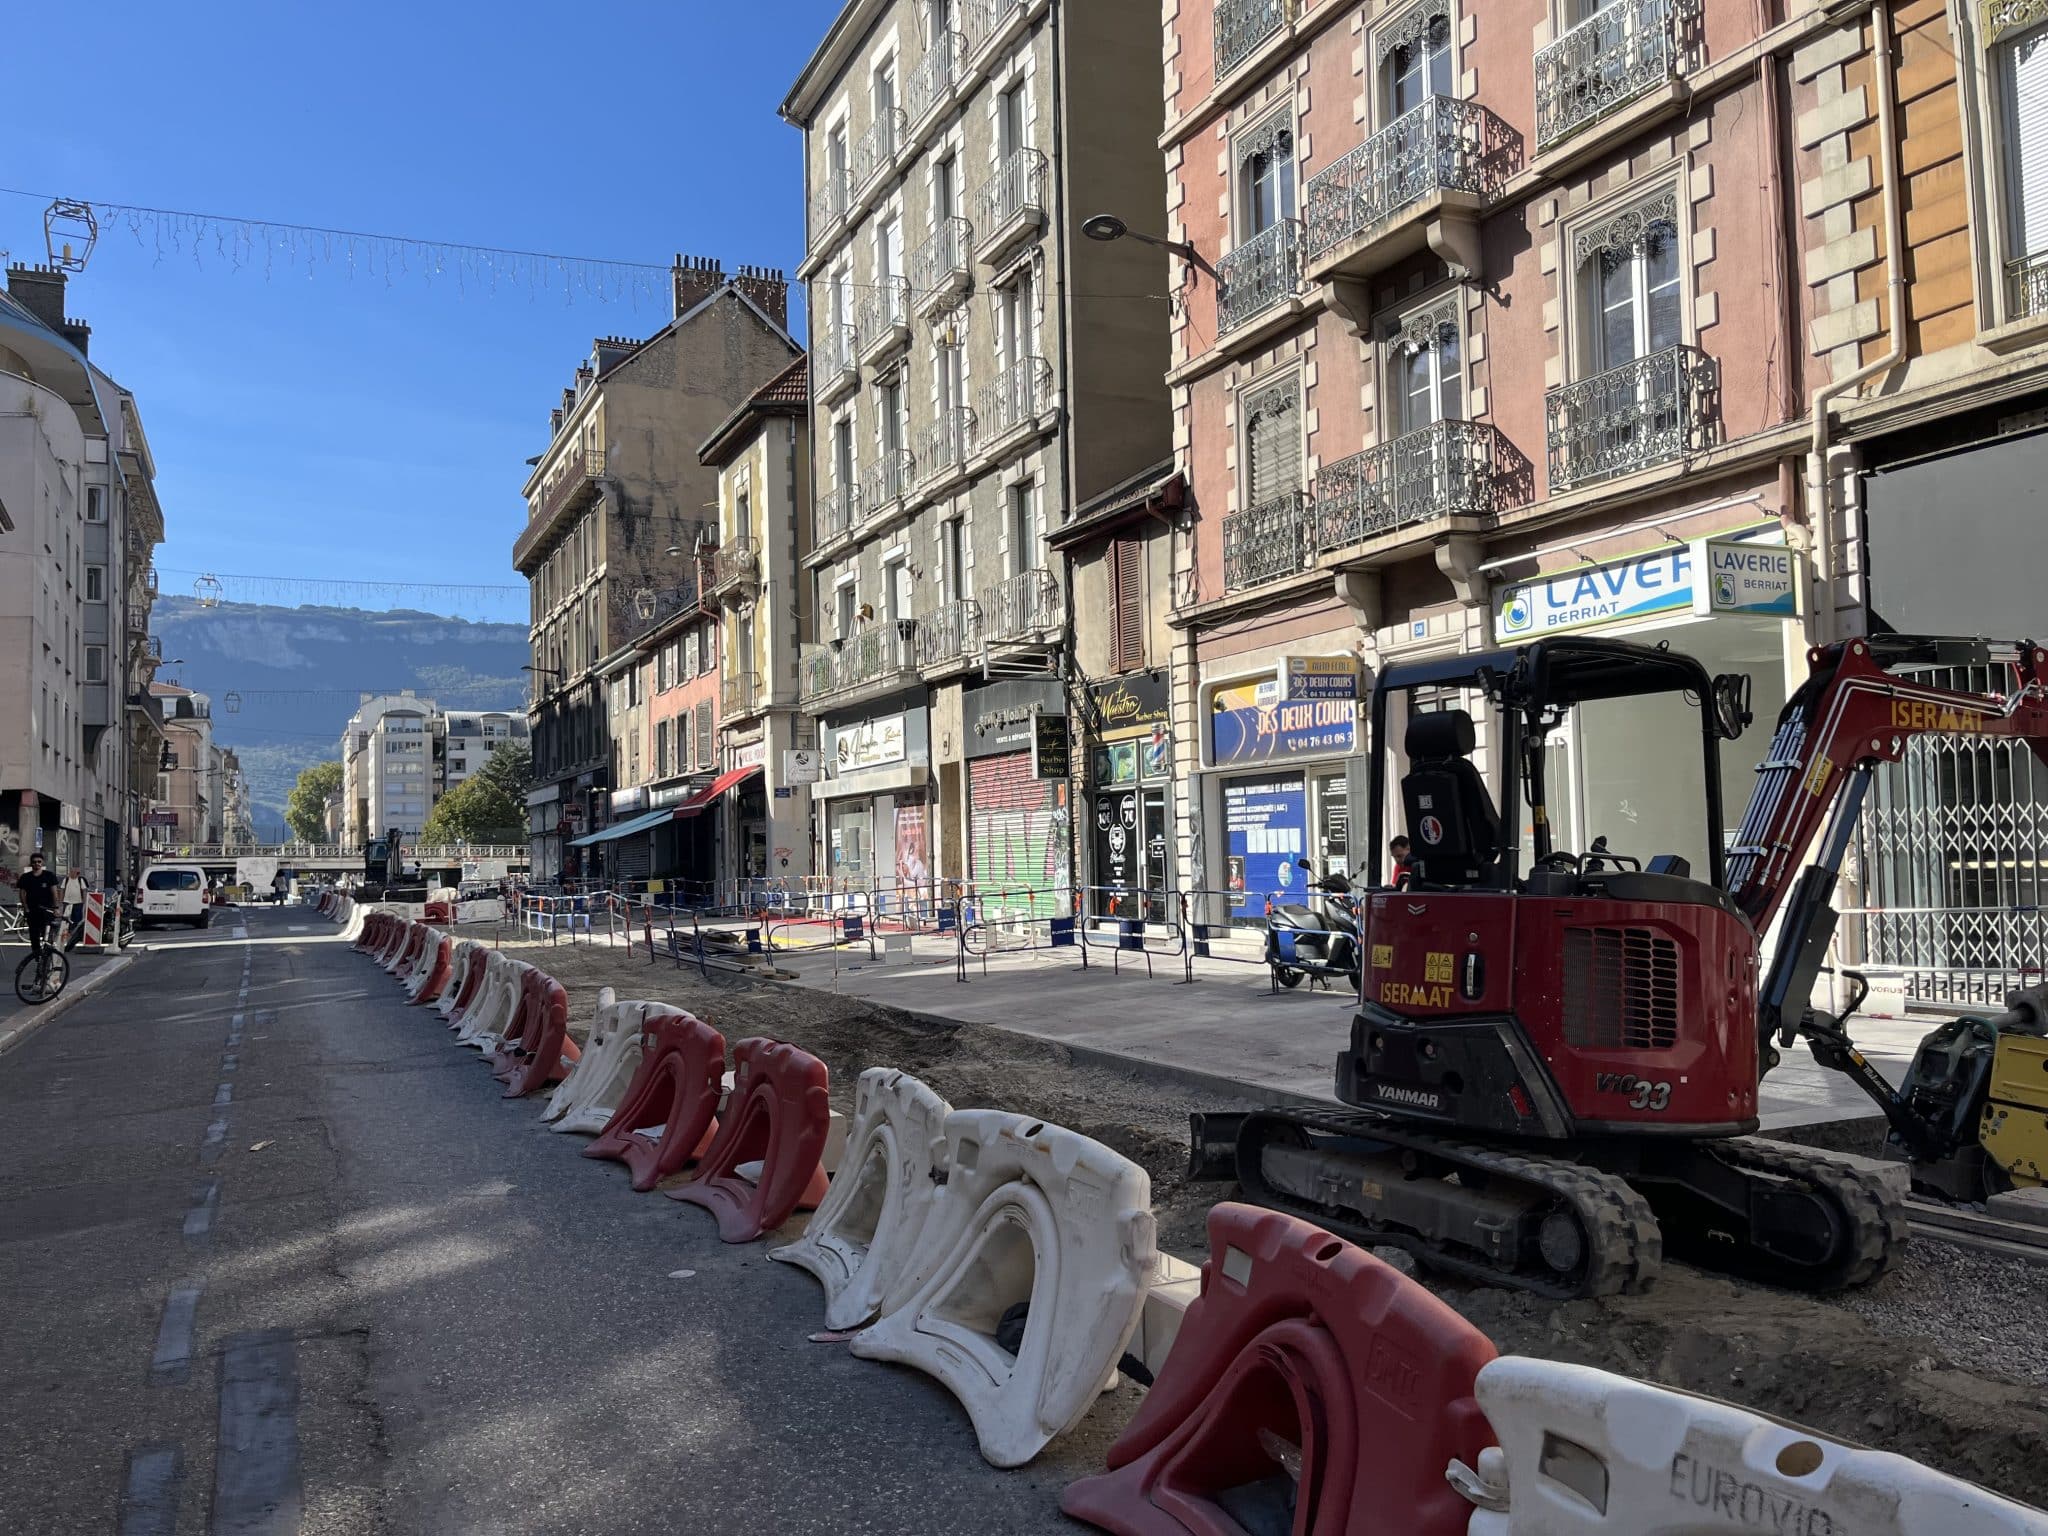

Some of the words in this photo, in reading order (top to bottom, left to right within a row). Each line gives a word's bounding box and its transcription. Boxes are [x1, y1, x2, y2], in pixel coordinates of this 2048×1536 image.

[1714, 551, 1787, 574] LAVERIE
[1546, 550, 1692, 608] LAVER
[1744, 578, 1788, 591] BERRIAT
[1548, 602, 1619, 626] BERRIAT
[1258, 710, 1278, 735] DES
[1281, 704, 1312, 732] DEUX
[1298, 738, 1307, 748] 04
[1310, 736, 1320, 747] 76
[1322, 735, 1332, 745] 43
[1381, 982, 1454, 1008] ISERMAT
[1377, 1084, 1439, 1108] YANMAR
